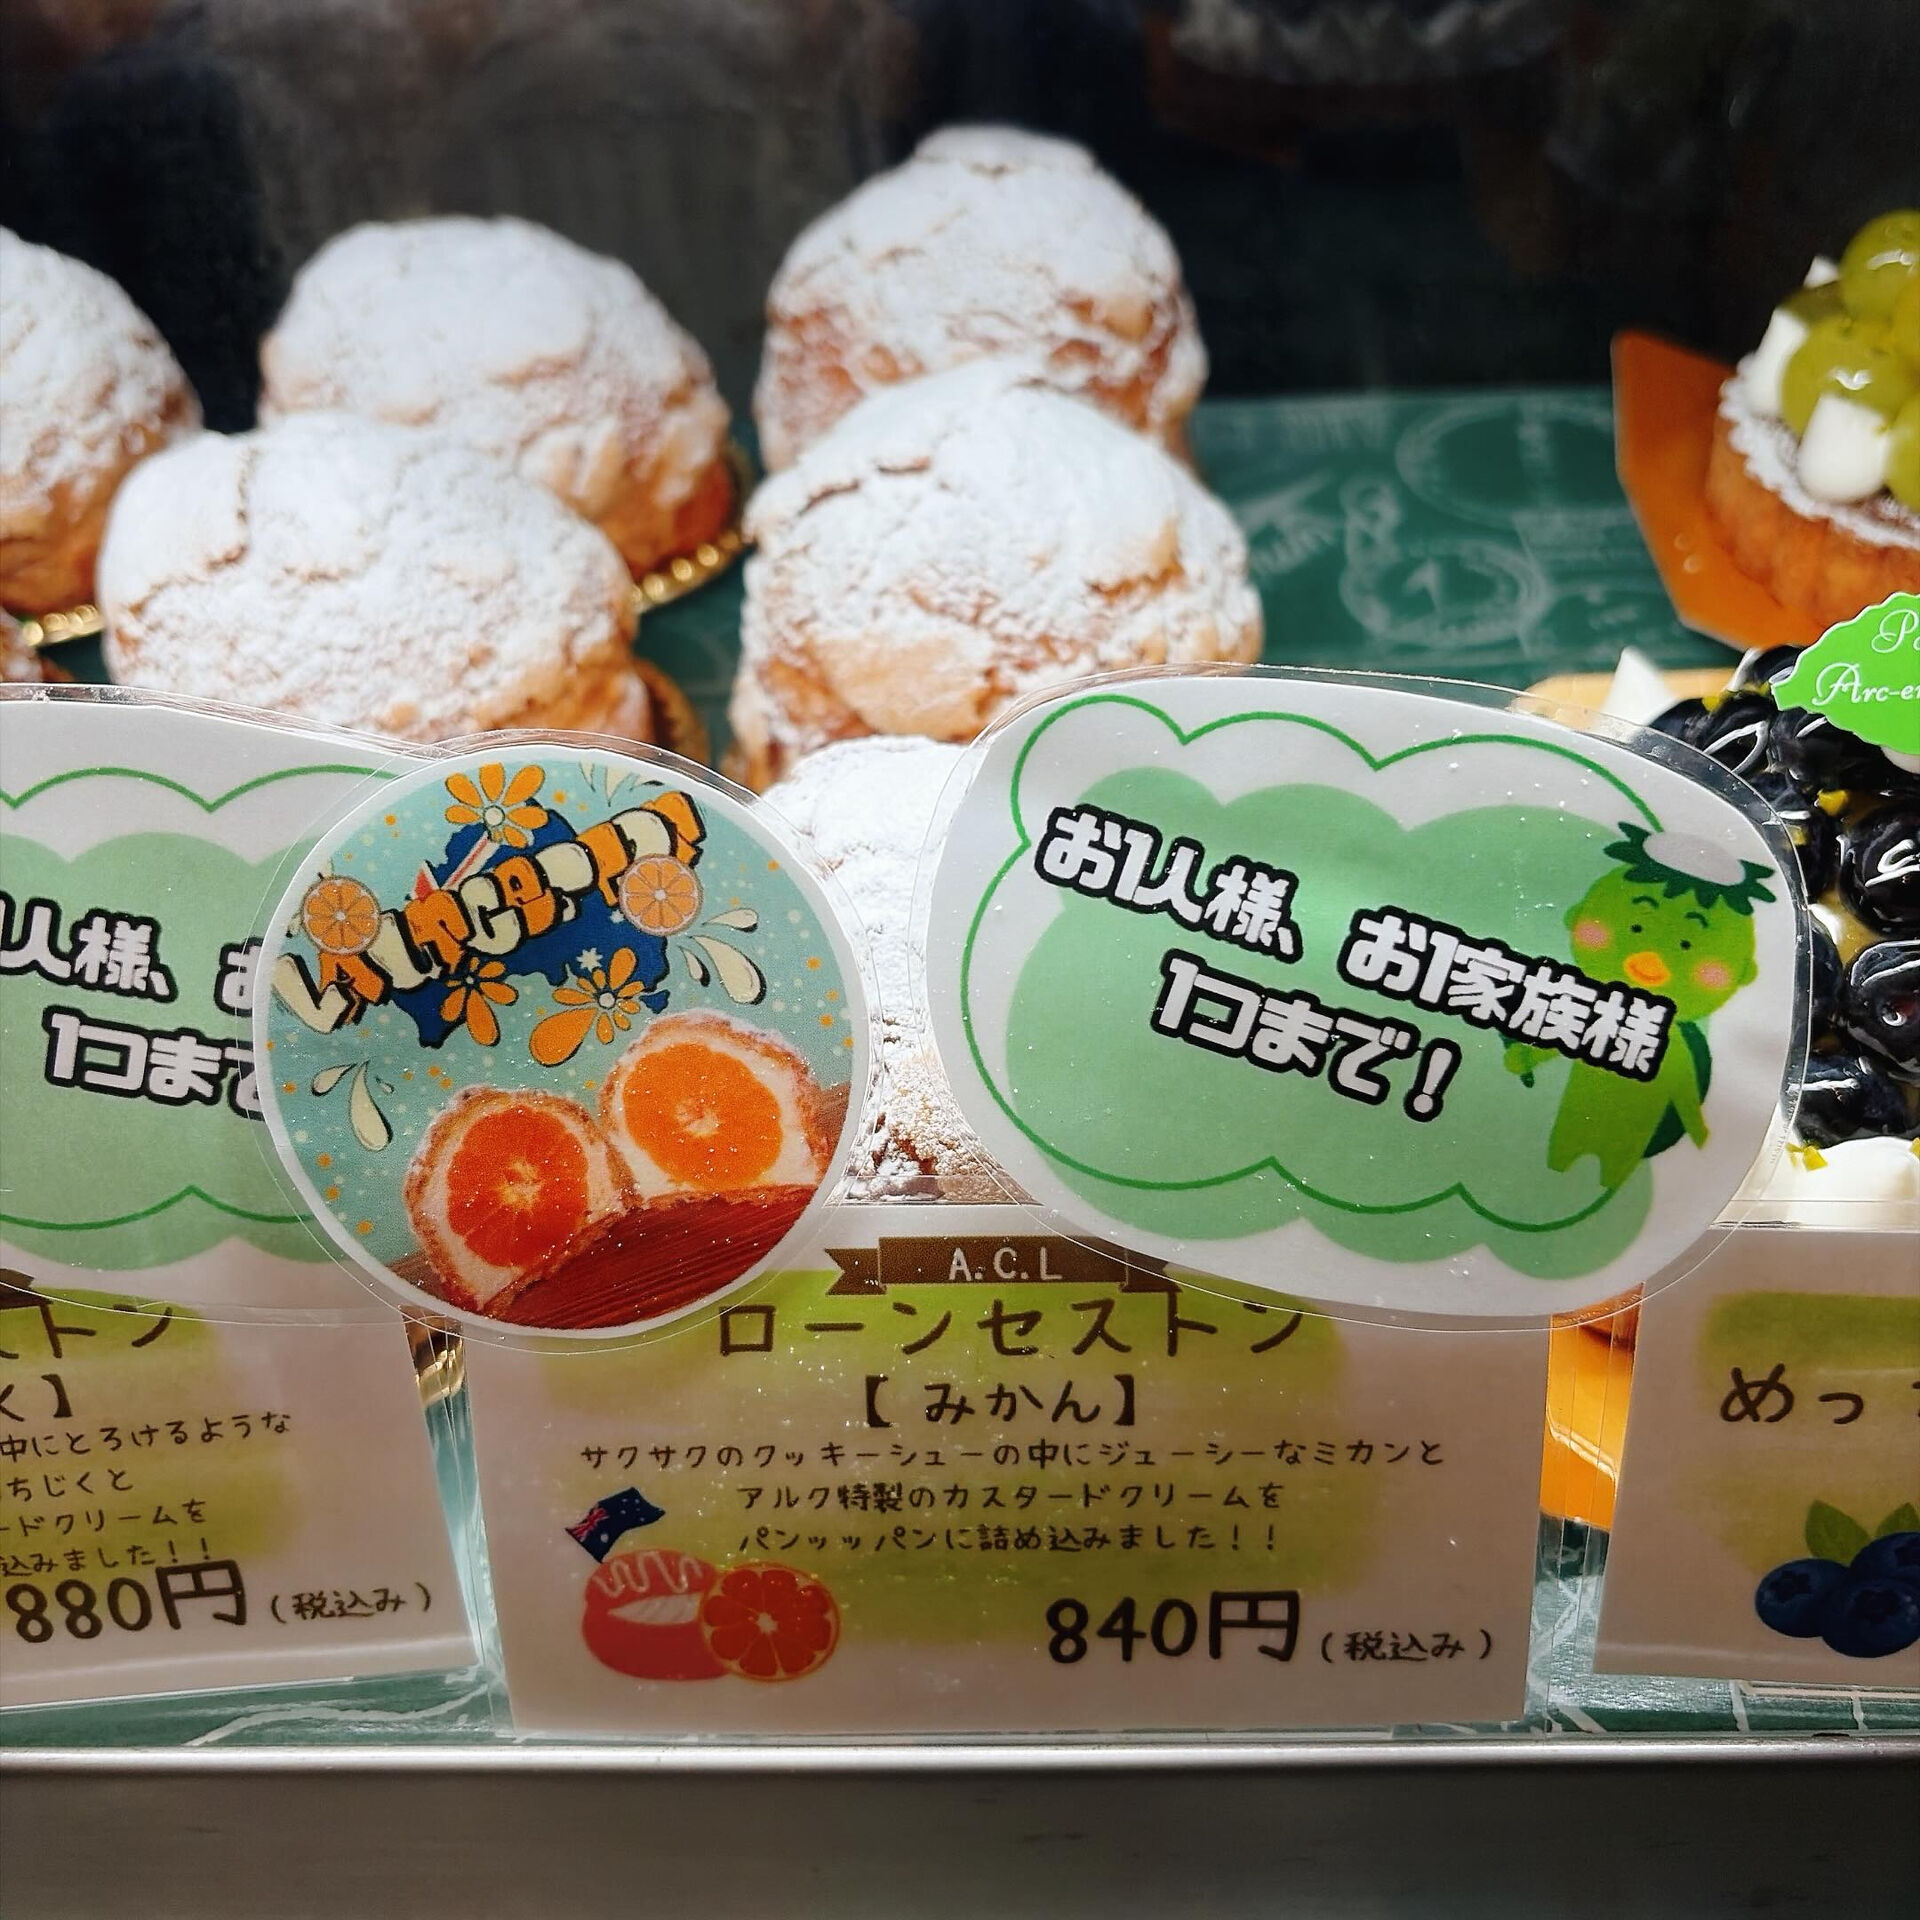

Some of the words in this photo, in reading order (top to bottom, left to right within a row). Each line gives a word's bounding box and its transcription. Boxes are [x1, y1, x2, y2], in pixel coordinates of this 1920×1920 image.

[1871, 608, 1920, 653] P
[1338, 906, 1677, 1081] お1家族様
[949, 1247, 1063, 1281] A.C.L
[0, 1302, 172, 1358] トン
[719, 1299, 1304, 1357] ローンセストン
[1720, 1363, 1920, 1425] めっ
[580, 1437, 1446, 1469] サクサクのクッキーシューの中にジューシーなミカンと
[738, 1482, 1285, 1511] アルク特製のカスタードクリームを
[6, 1559, 248, 1643] 880円
[1046, 1591, 1300, 1664] 840円
